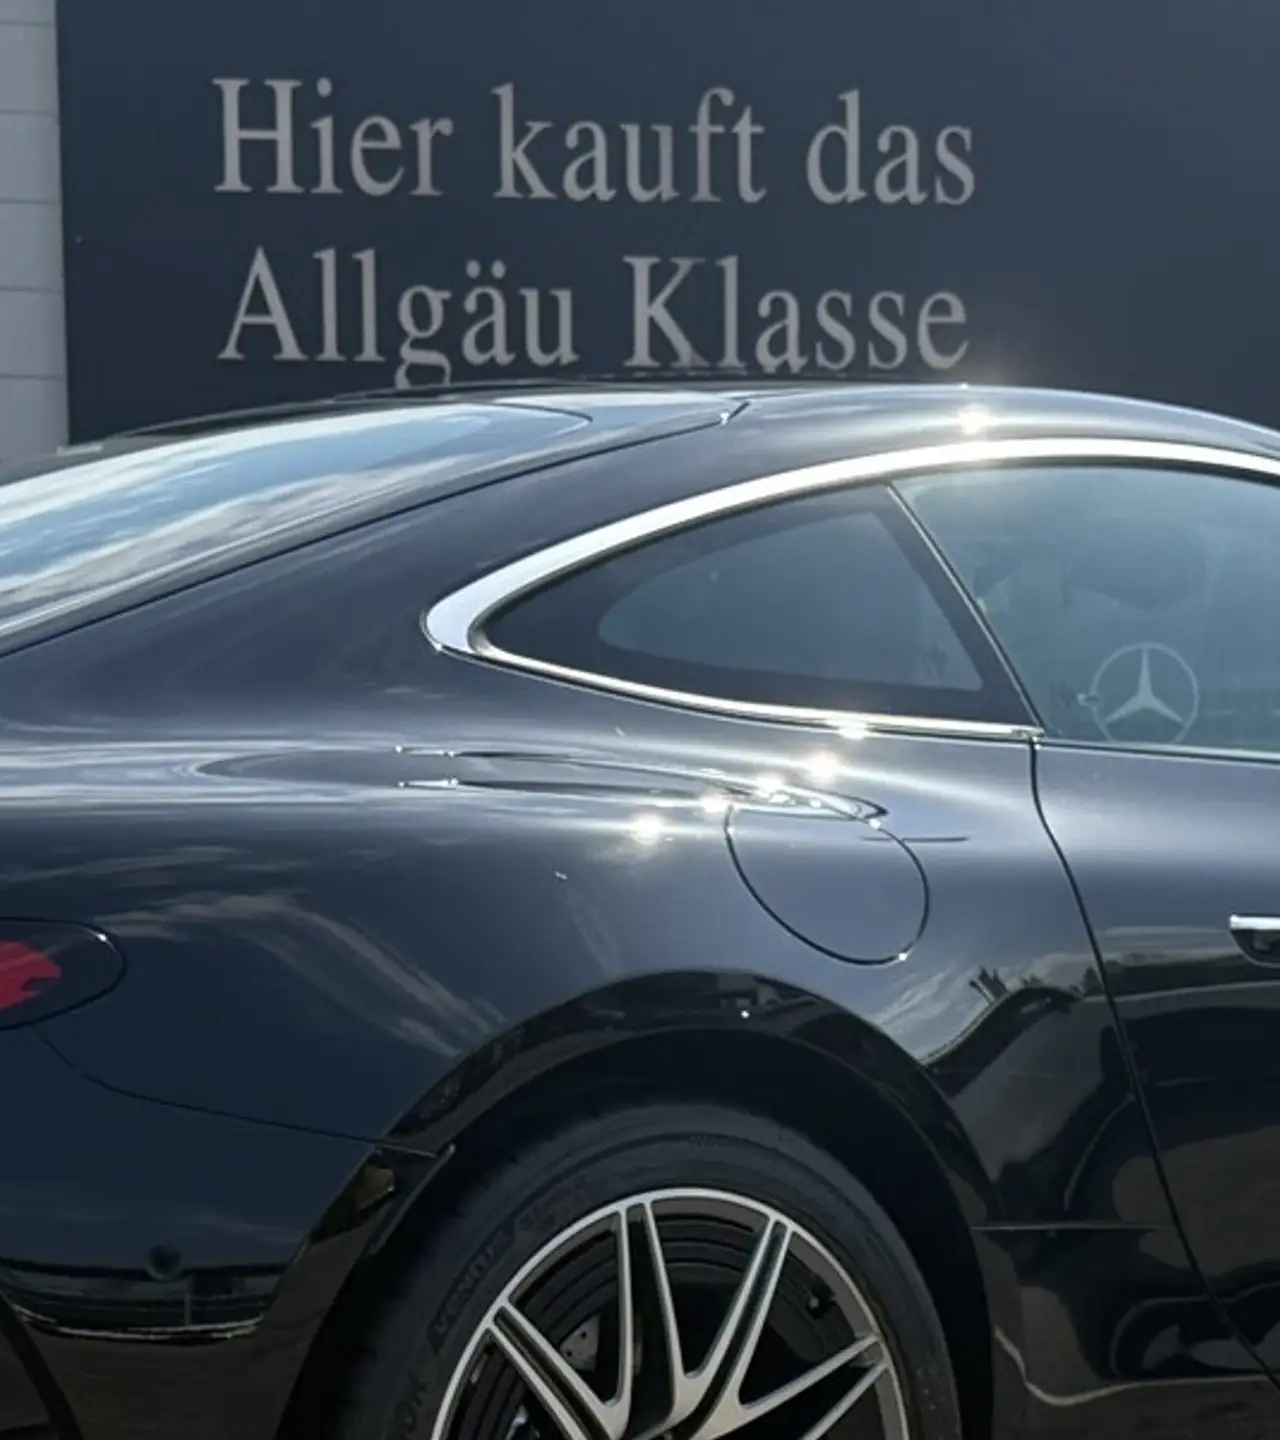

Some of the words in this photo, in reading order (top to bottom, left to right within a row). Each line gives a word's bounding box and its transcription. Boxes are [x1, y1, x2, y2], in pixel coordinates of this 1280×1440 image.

[212, 77, 453, 197] Hier
[492, 83, 767, 204] kauft
[806, 88, 975, 206] das
[218, 247, 579, 391] Allgäu
[623, 255, 971, 374] Klasse
